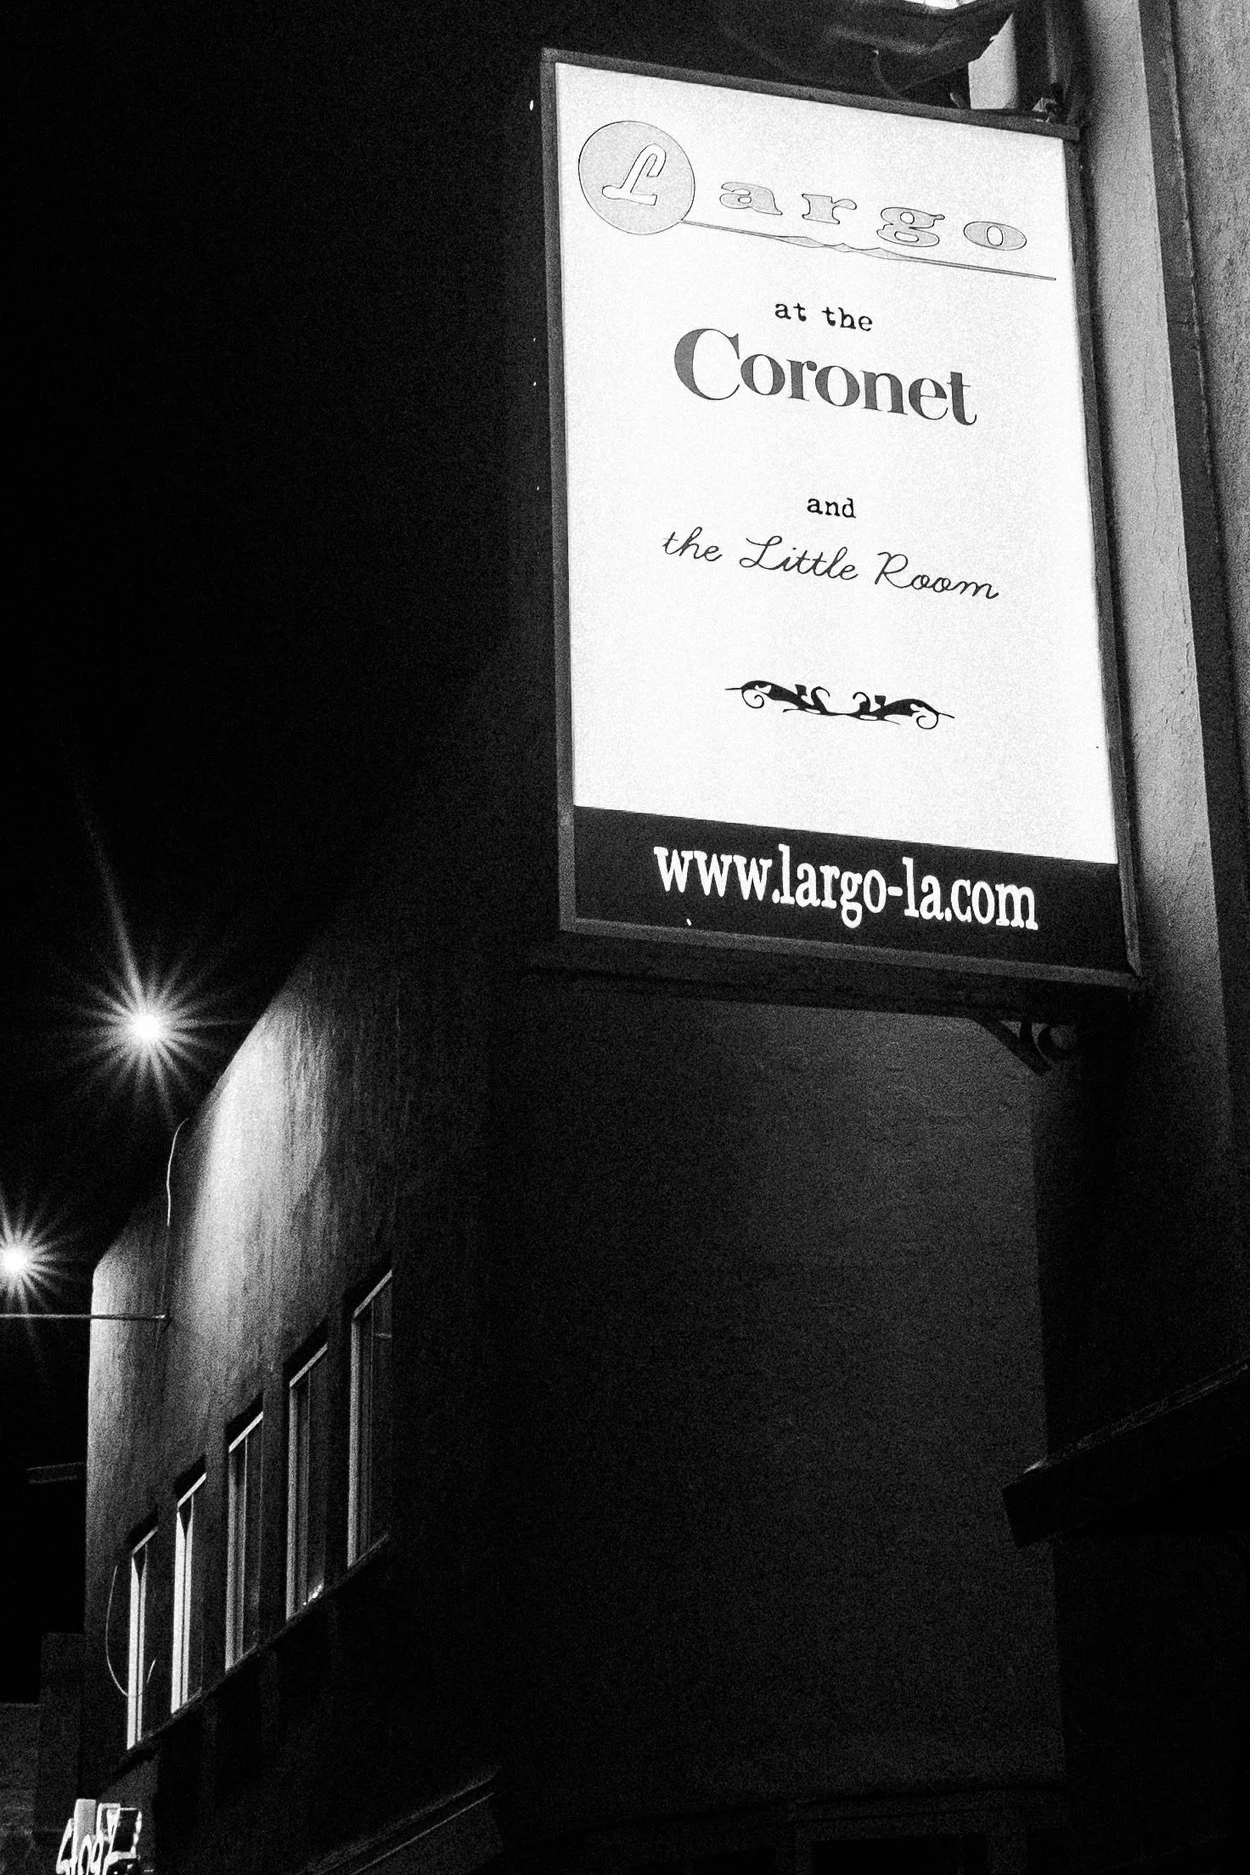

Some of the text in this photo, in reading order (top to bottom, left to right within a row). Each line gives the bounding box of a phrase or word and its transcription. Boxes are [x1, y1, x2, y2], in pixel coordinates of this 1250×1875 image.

[601, 142, 1028, 252] Largo
[774, 302, 874, 333] at the
[673, 327, 978, 426] Coronet
[806, 497, 857, 519] and
[662, 526, 1000, 601] the Little Room
[653, 844, 1039, 931] www.largo-la.com
